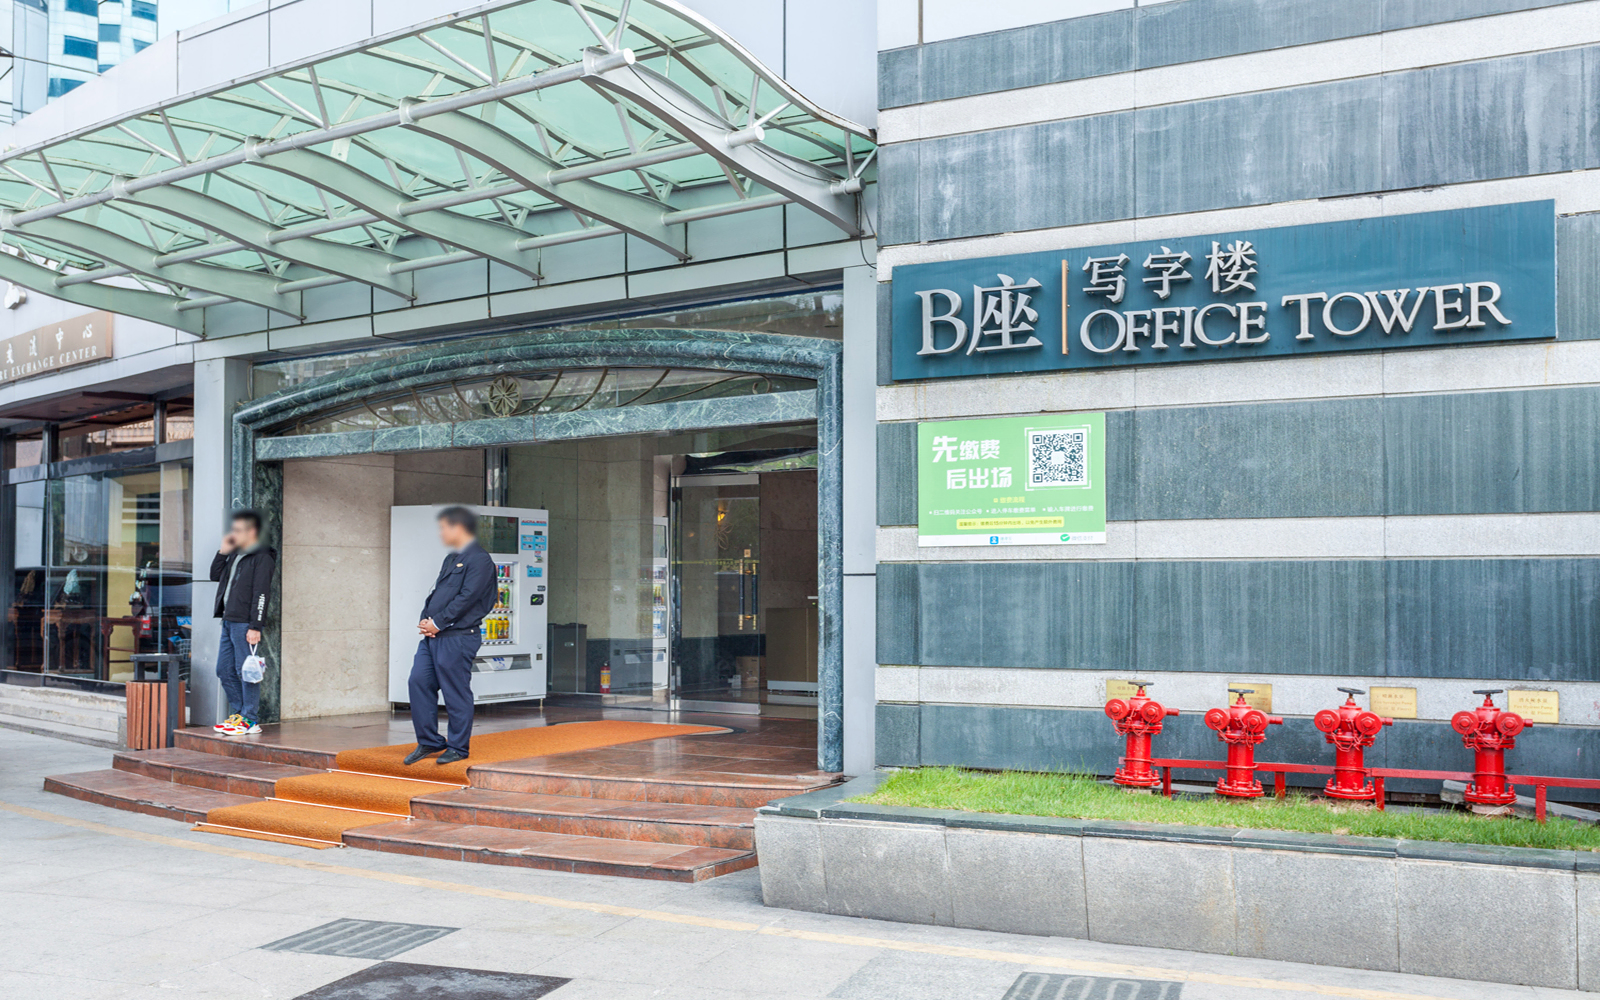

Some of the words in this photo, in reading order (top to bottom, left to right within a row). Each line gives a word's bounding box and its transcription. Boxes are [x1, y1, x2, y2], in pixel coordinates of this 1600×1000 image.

[1081, 240, 1258, 304] 写字楼
[914, 273, 1043, 356] B座
[1080, 301, 1270, 353] OFFICE
[1281, 281, 1512, 340] TOWER
[11, 356, 55, 377] EXCHANGE
[59, 345, 97, 365] CENTER
[931, 435, 1000, 463] 先缴费
[946, 466, 1012, 490] 后出场
